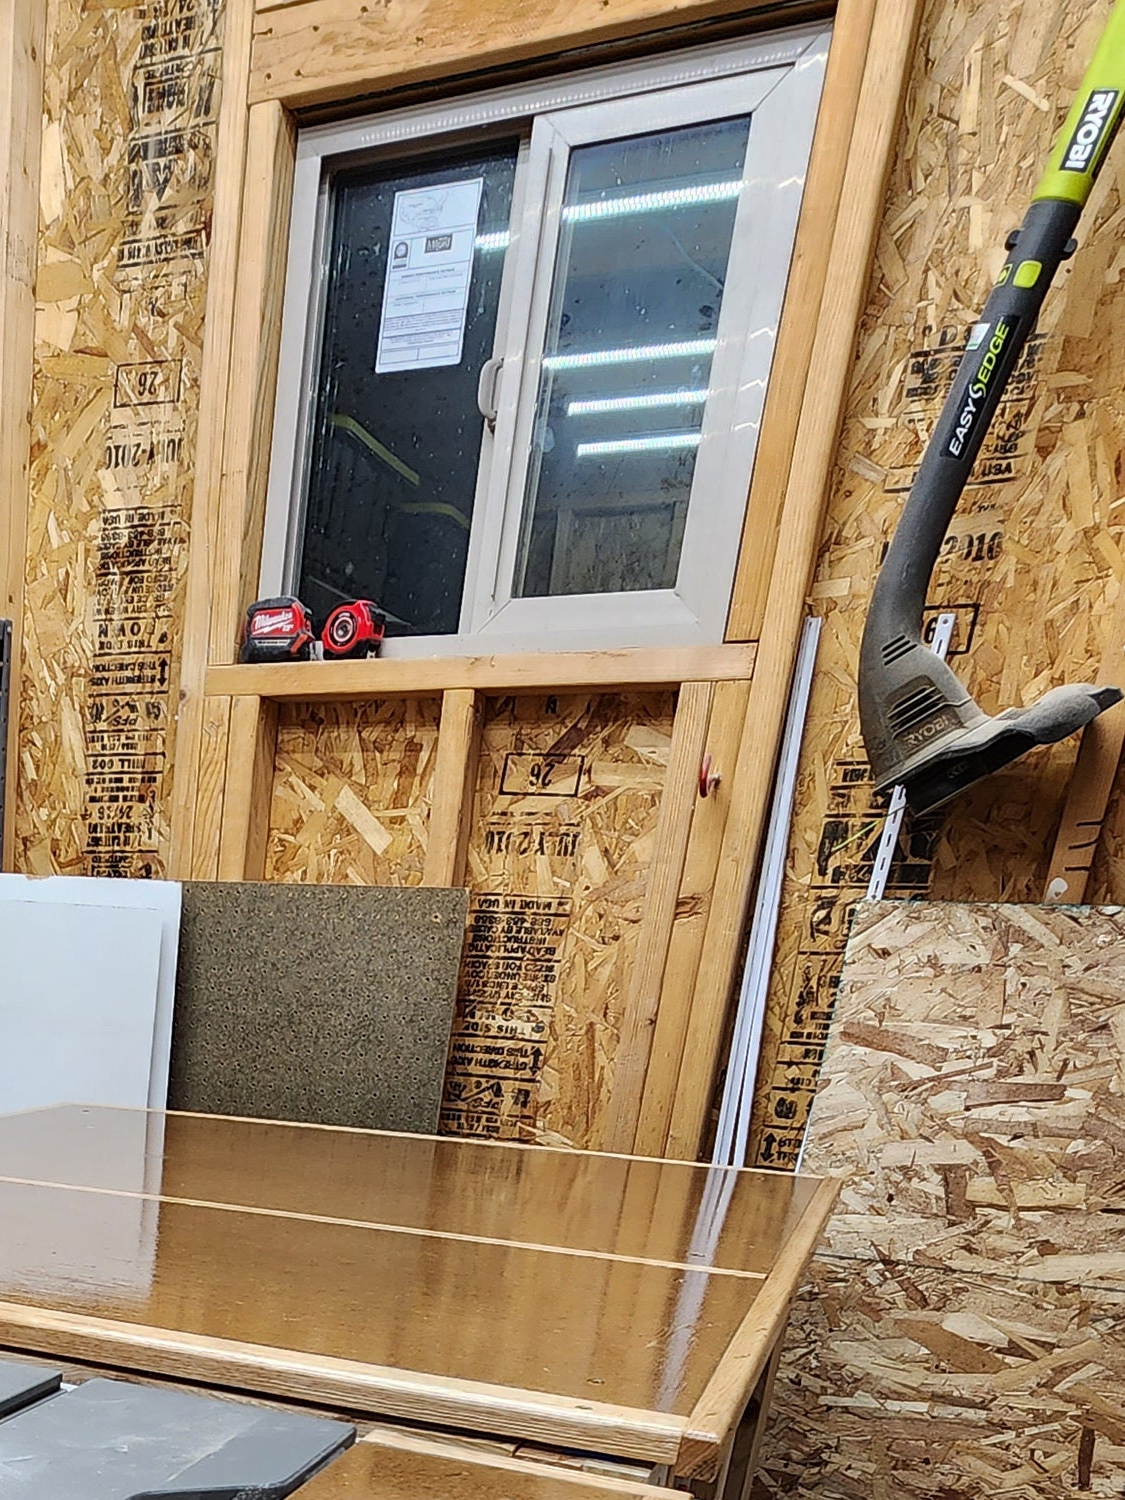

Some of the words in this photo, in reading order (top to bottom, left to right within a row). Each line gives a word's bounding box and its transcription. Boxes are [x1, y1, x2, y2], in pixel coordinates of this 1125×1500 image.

[1064, 91, 1116, 169] RYOBI
[138, 371, 159, 397] 26
[948, 397, 977, 457] EASY
[977, 316, 1010, 384] EDGE
[255, 611, 293, 630] Milwaukee
[903, 715, 949, 746] RYOBI
[91, 758, 115, 770] 002
[529, 761, 556, 788] 26
[520, 899, 553, 911] MADE
